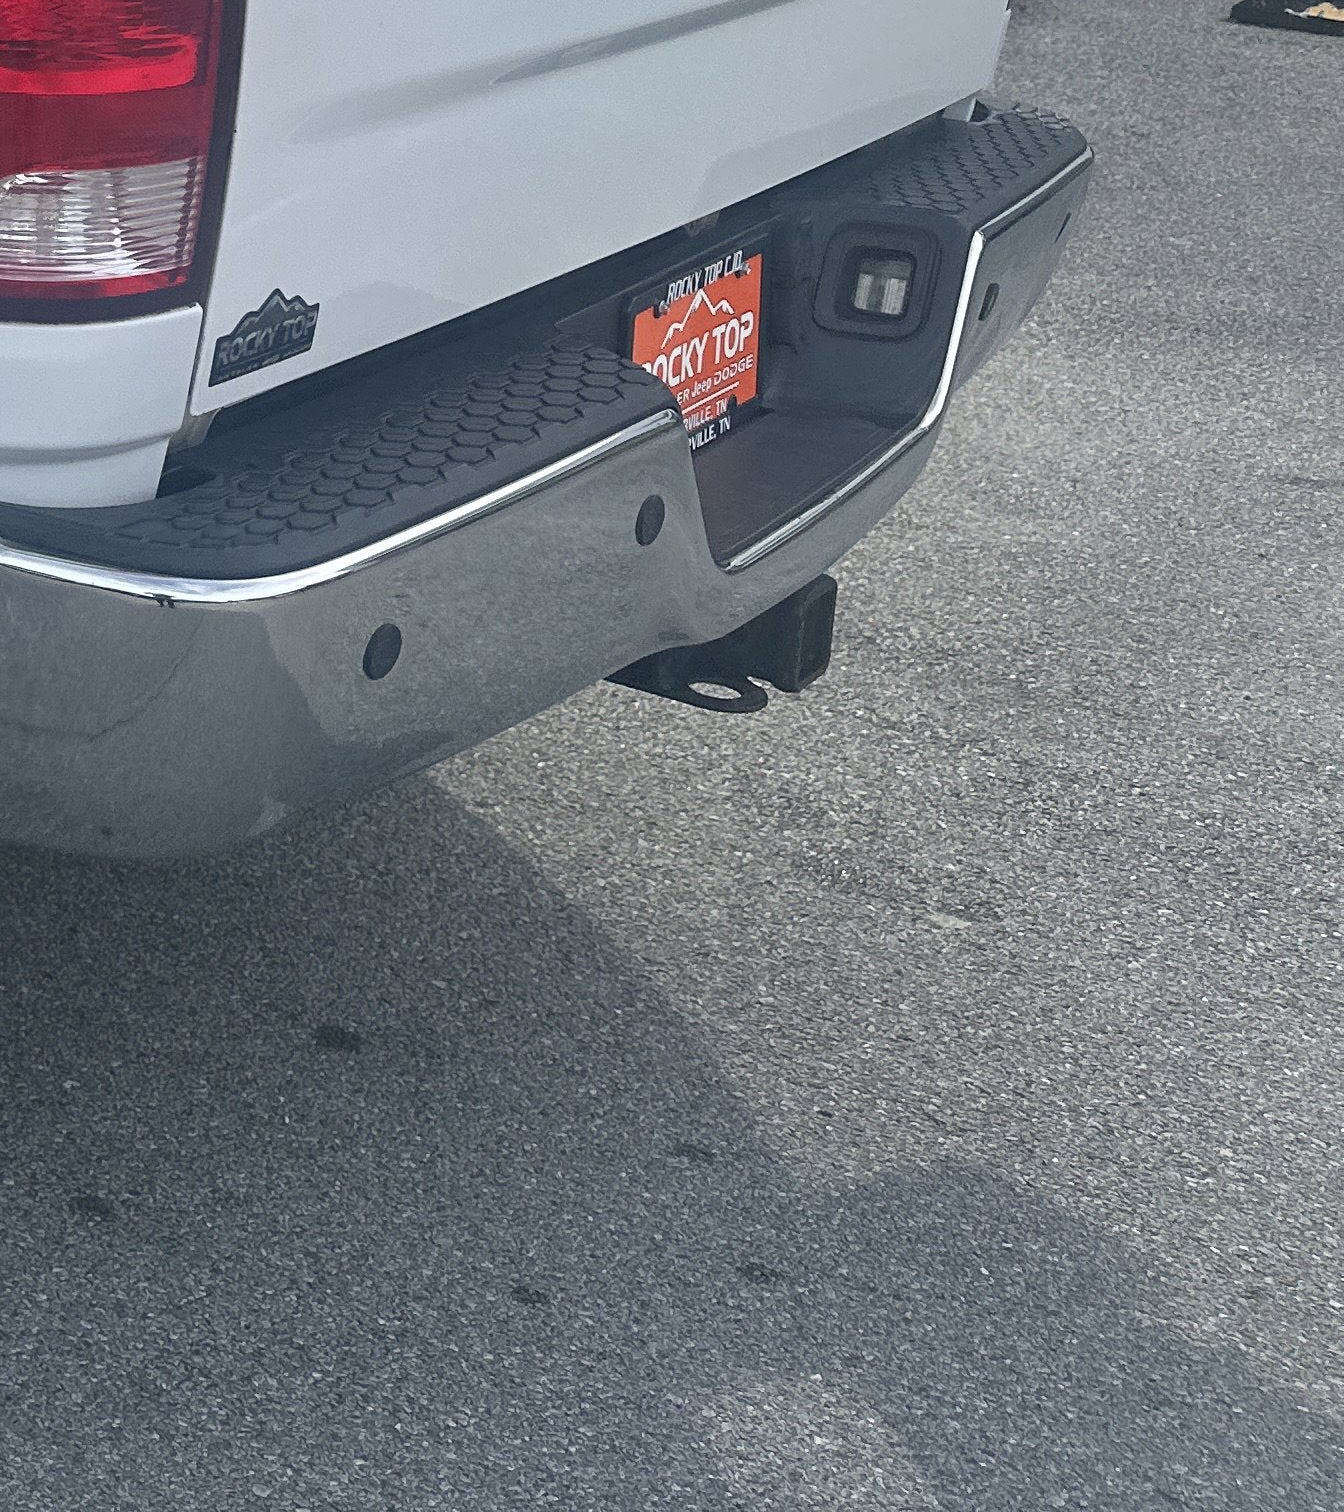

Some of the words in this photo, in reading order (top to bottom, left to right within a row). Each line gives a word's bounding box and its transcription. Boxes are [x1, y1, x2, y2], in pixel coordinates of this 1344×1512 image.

[667, 270, 702, 304] ROCKY
[704, 259, 723, 287] TOP
[282, 310, 317, 343] TOP
[713, 311, 754, 365] TOP
[691, 377, 712, 398] Jeep
[713, 354, 754, 386] DODGE
[716, 397, 729, 416] TN
[688, 424, 716, 450] VILLE,
[719, 415, 732, 435] TN
